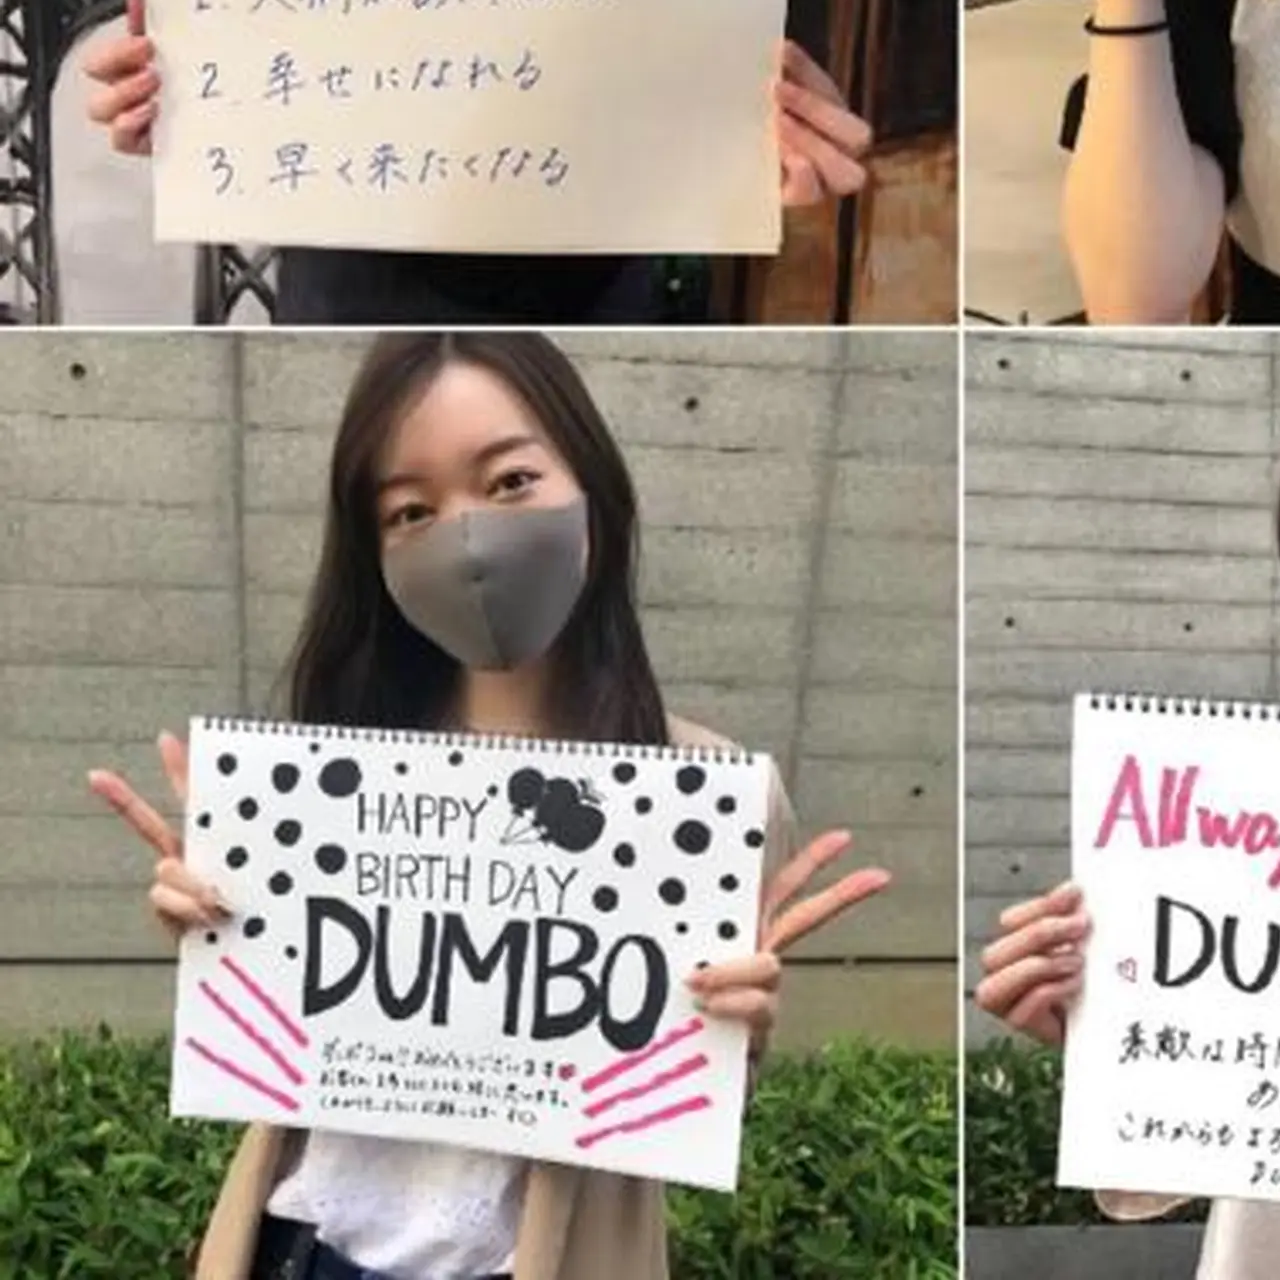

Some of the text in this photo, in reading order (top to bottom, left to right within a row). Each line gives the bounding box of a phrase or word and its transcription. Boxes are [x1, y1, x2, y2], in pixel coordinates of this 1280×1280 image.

[263, 52, 544, 107] 幸せになれる
[268, 142, 572, 190] 早く来たくなる
[356, 792, 490, 842] HAPPY
[355, 851, 580, 916] BIRTH DAY
[302, 895, 671, 1053] DUMBO
